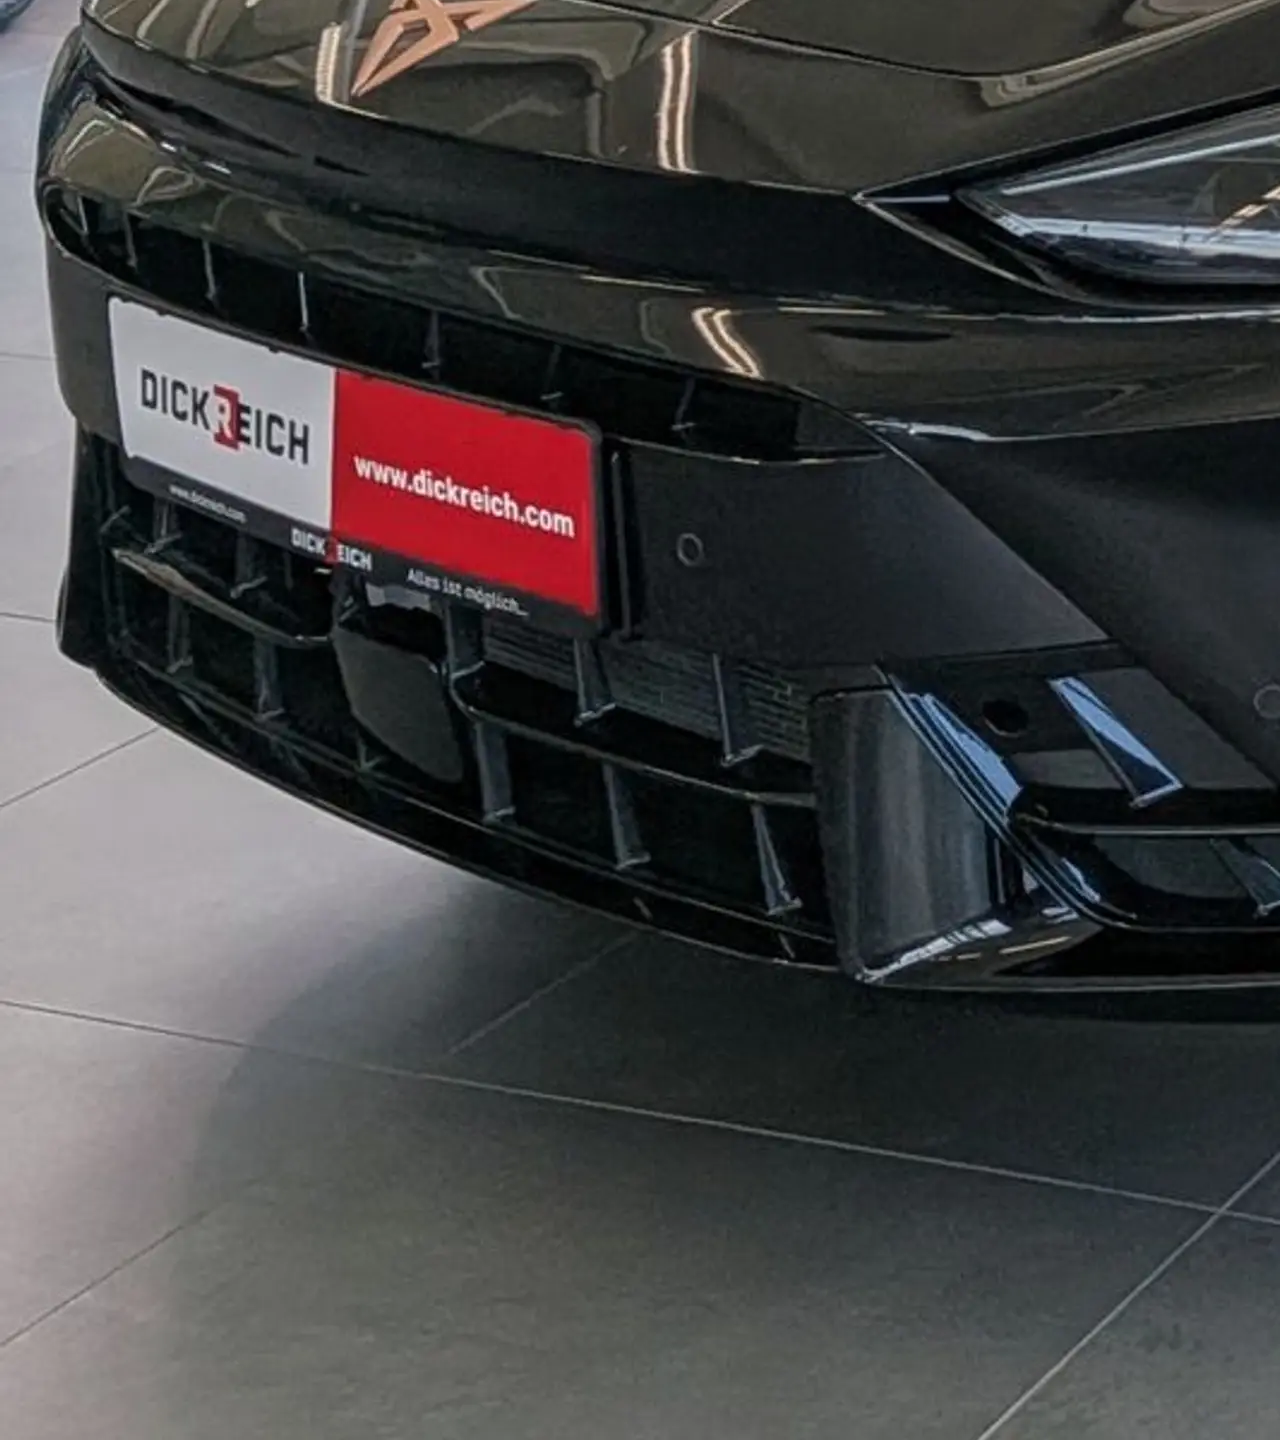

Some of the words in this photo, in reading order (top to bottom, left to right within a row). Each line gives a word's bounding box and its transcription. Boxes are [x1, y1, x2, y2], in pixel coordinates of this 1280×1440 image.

[140, 367, 309, 465] DICKREICH
[353, 455, 576, 539] www.dickreich.com
[406, 567, 440, 591] Alles
[442, 576, 462, 597] ist
